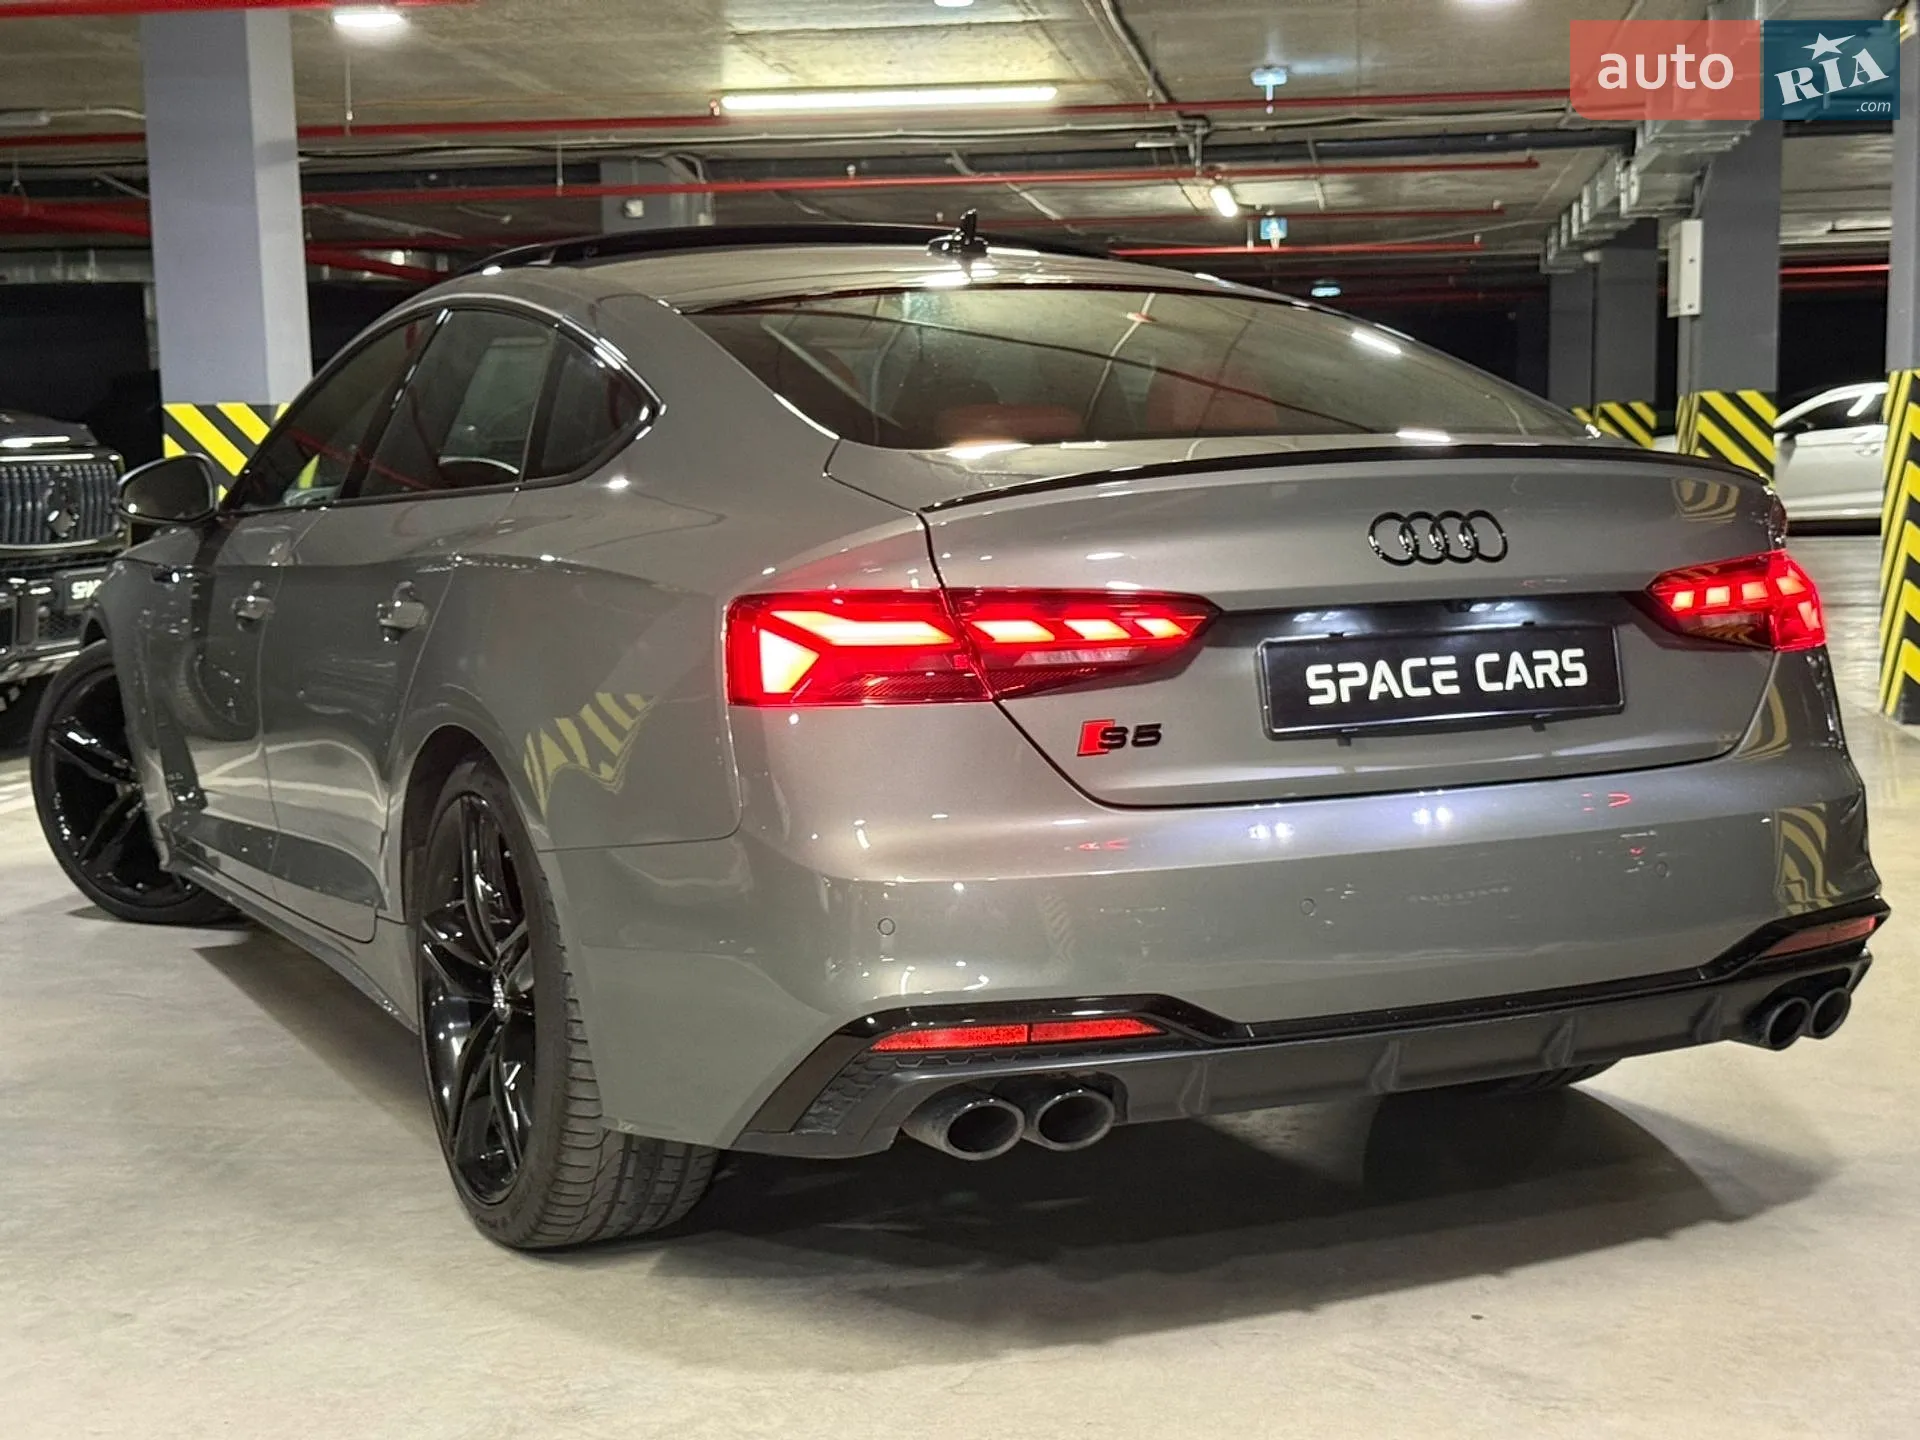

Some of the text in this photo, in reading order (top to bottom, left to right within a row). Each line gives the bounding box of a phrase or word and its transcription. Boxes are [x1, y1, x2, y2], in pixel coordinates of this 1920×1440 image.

[1305, 648, 1588, 706] SPACE CARS
[1097, 723, 1162, 750] S5
